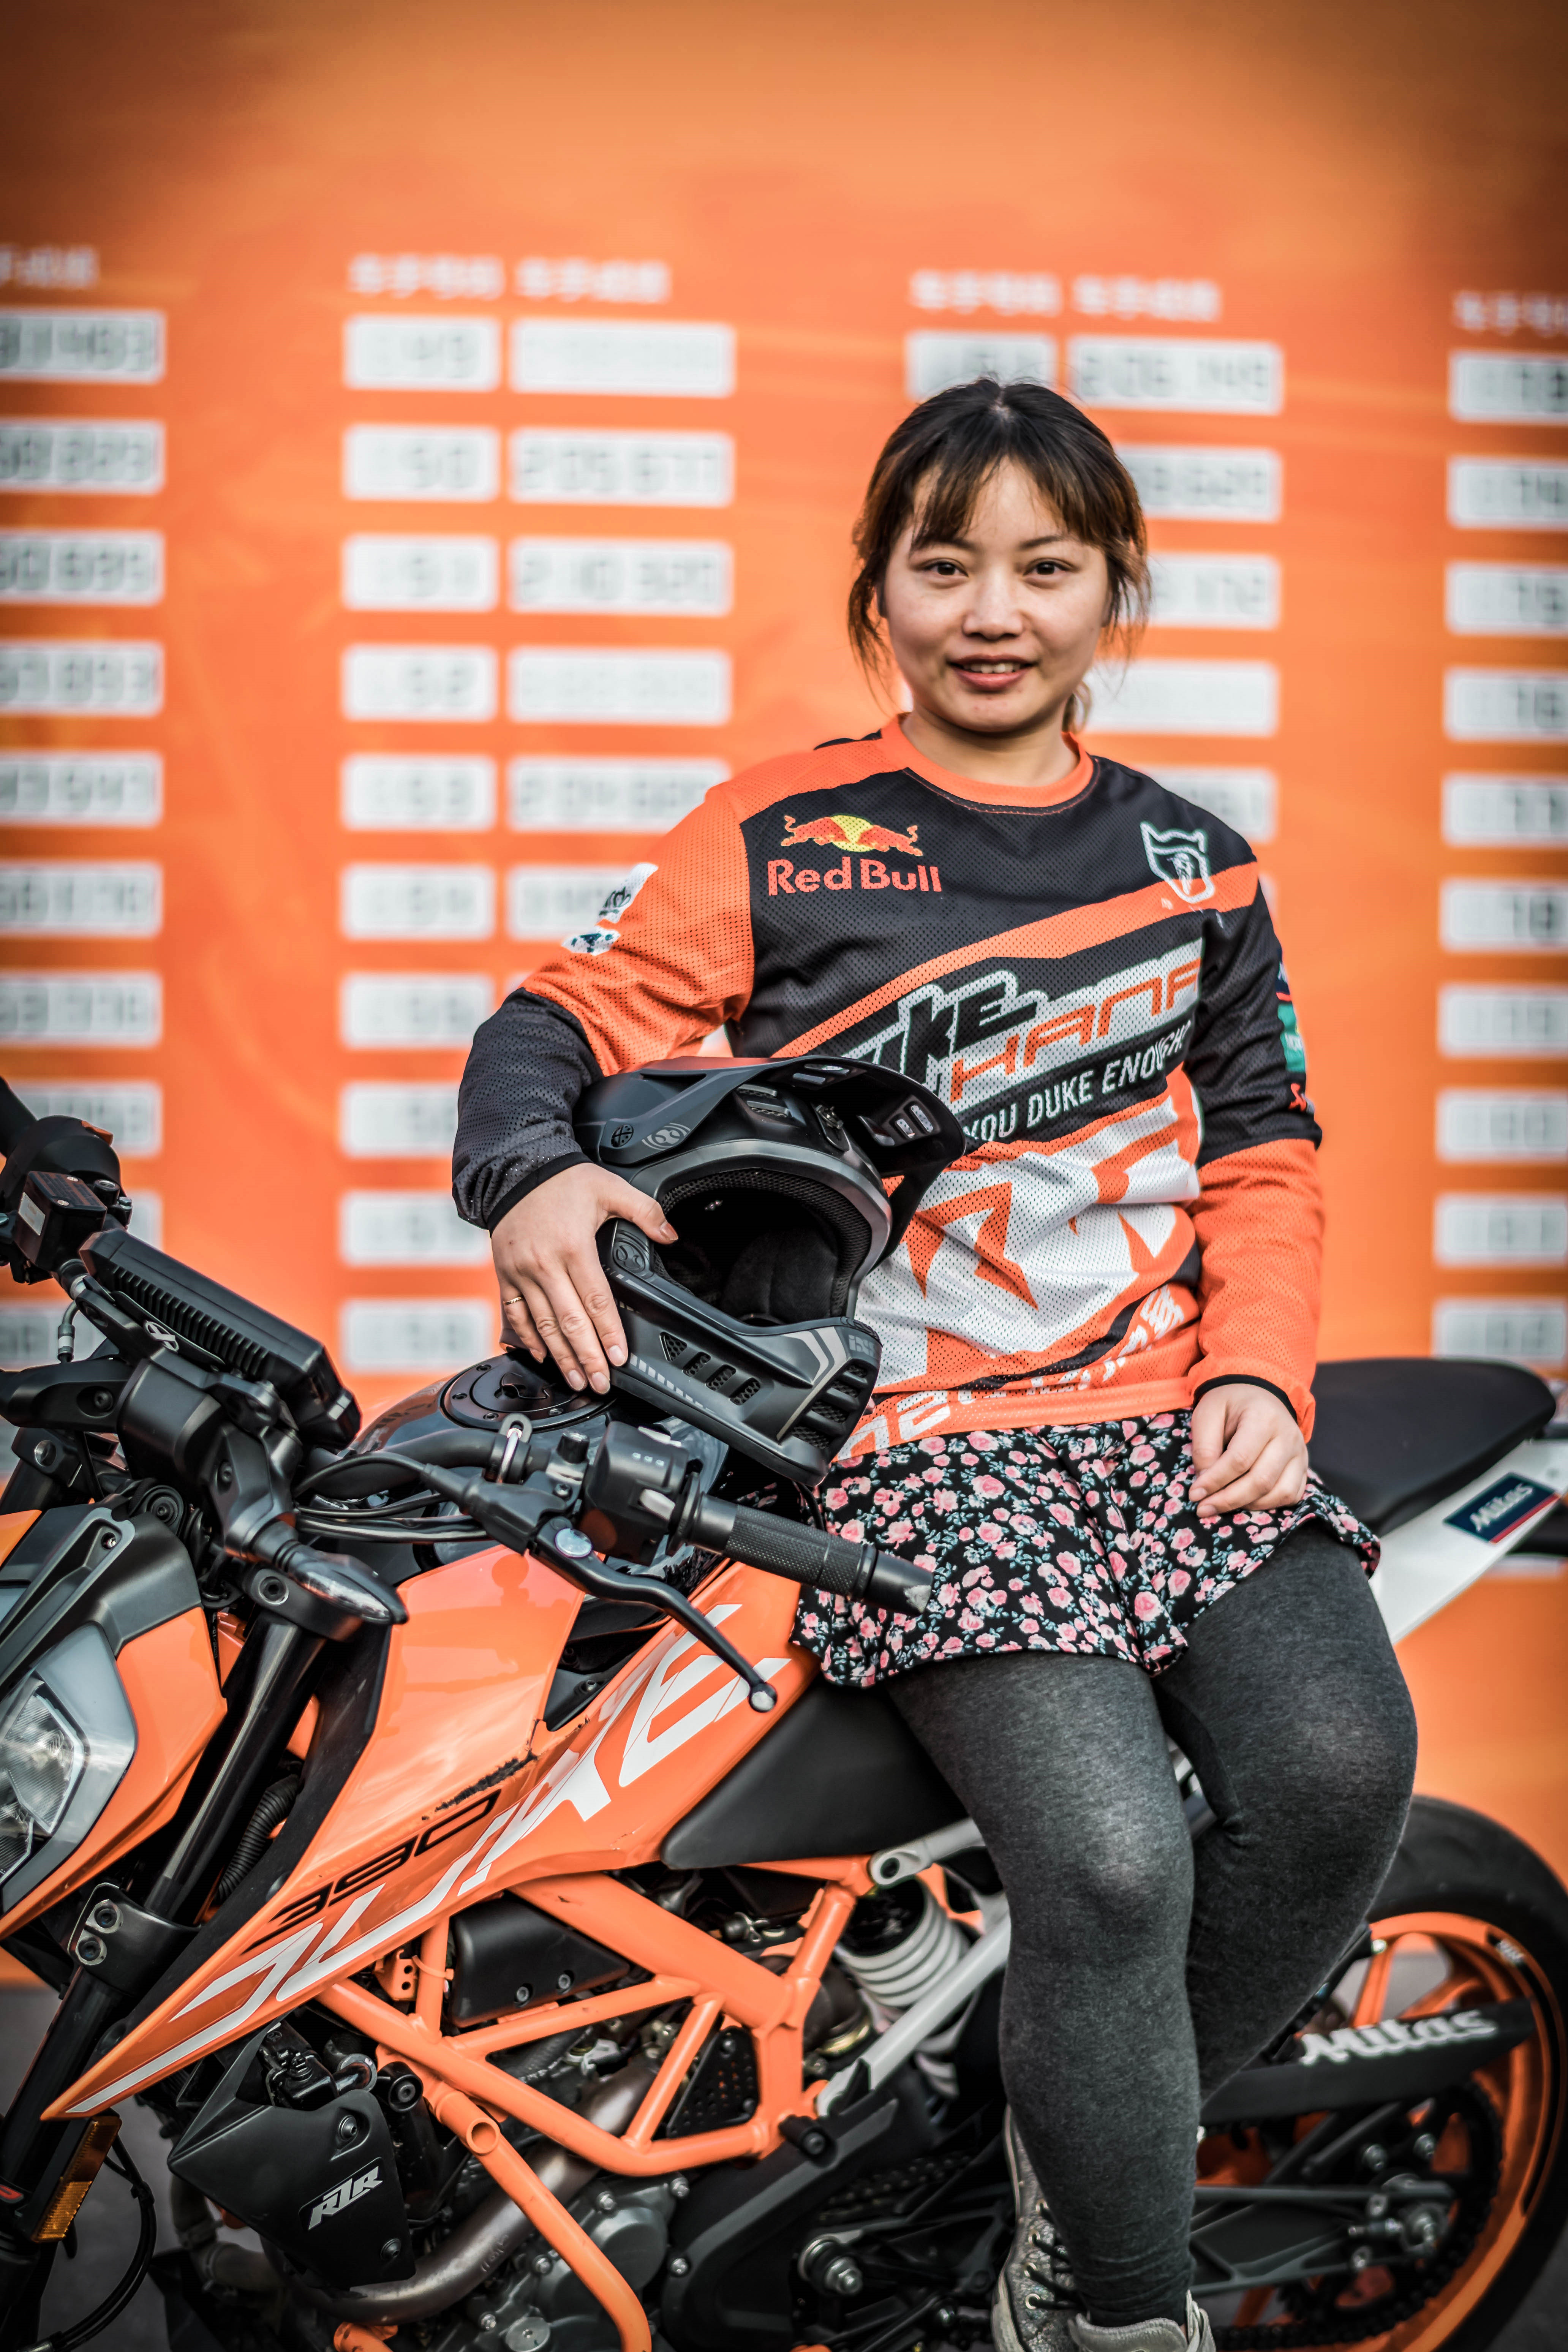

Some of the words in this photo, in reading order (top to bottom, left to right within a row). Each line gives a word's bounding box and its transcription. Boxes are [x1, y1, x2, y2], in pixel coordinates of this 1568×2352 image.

[767, 856, 852, 896] Red
[860, 858, 942, 892] Bull
[963, 1103, 1017, 1141] YOU
[1027, 1070, 1094, 1129] DUKE
[239, 1788, 502, 1956] 390
